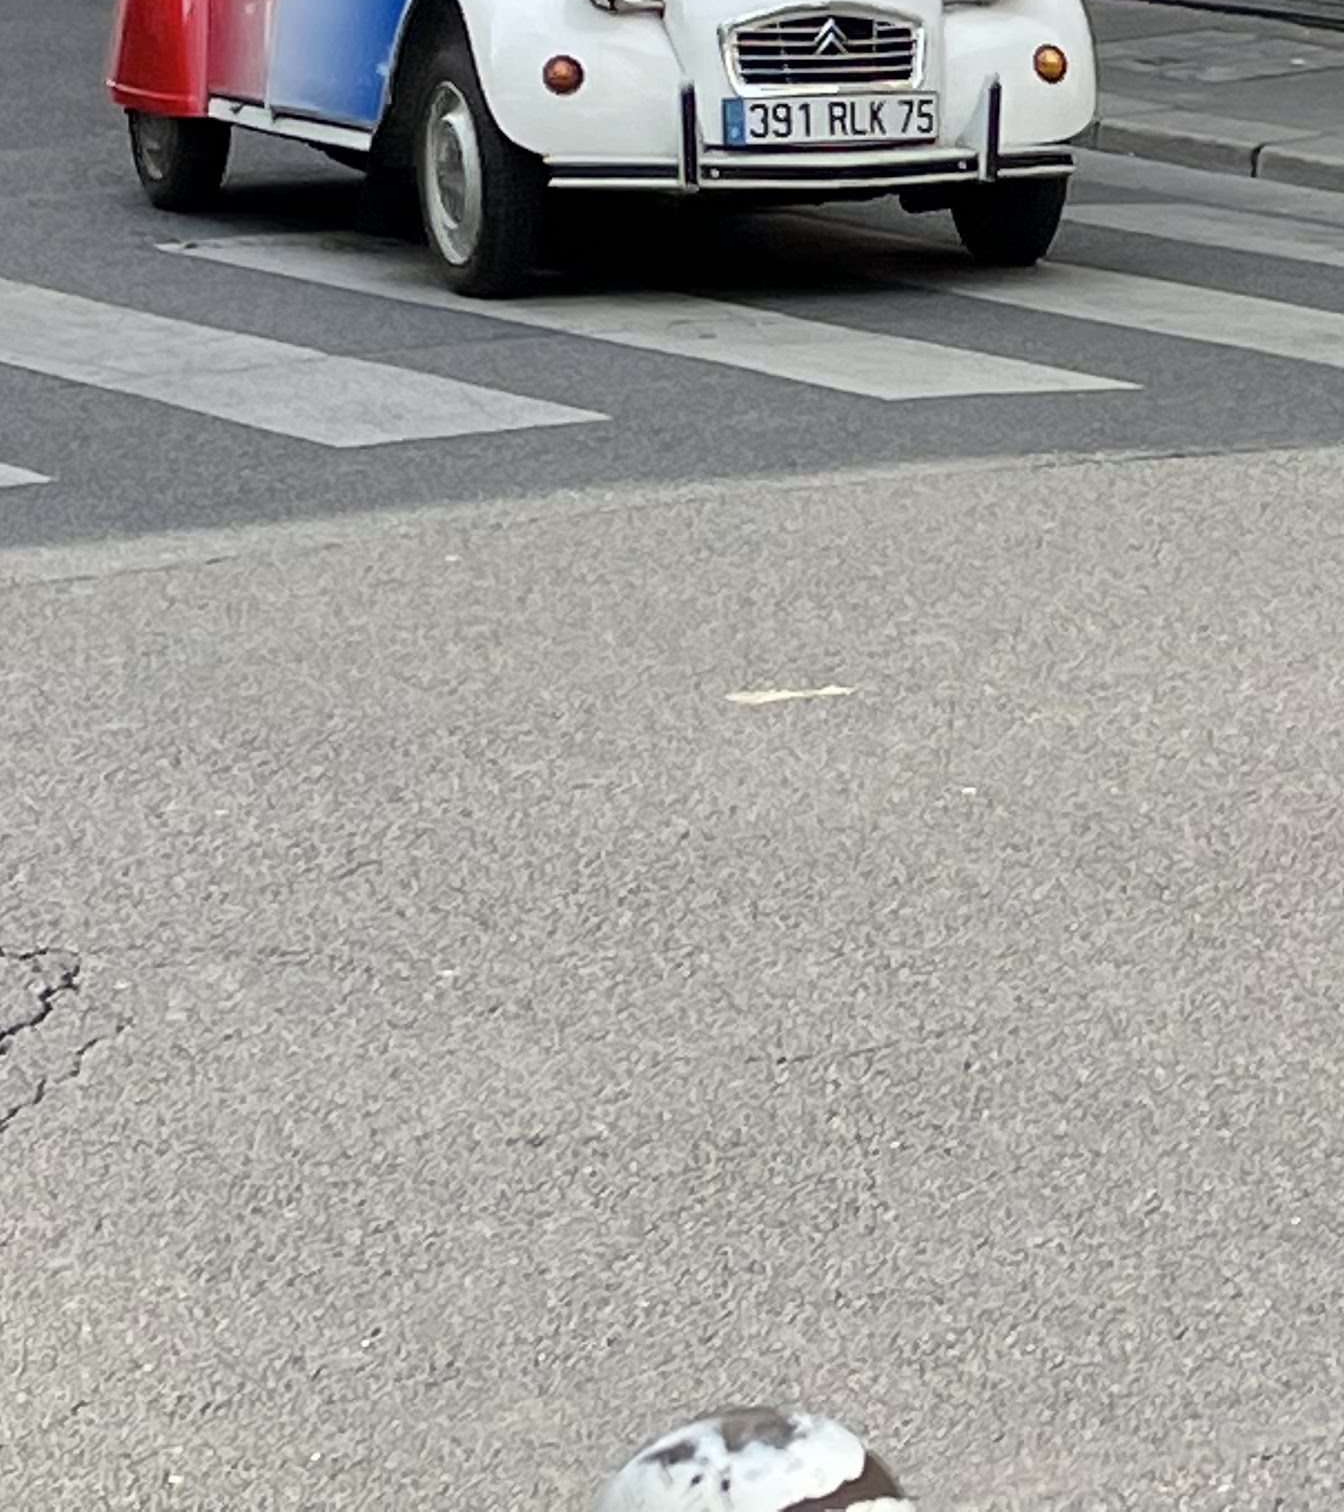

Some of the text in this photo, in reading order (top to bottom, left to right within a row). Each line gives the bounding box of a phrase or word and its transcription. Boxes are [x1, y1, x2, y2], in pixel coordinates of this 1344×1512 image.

[750, 99, 934, 138] 391 RLK 75
